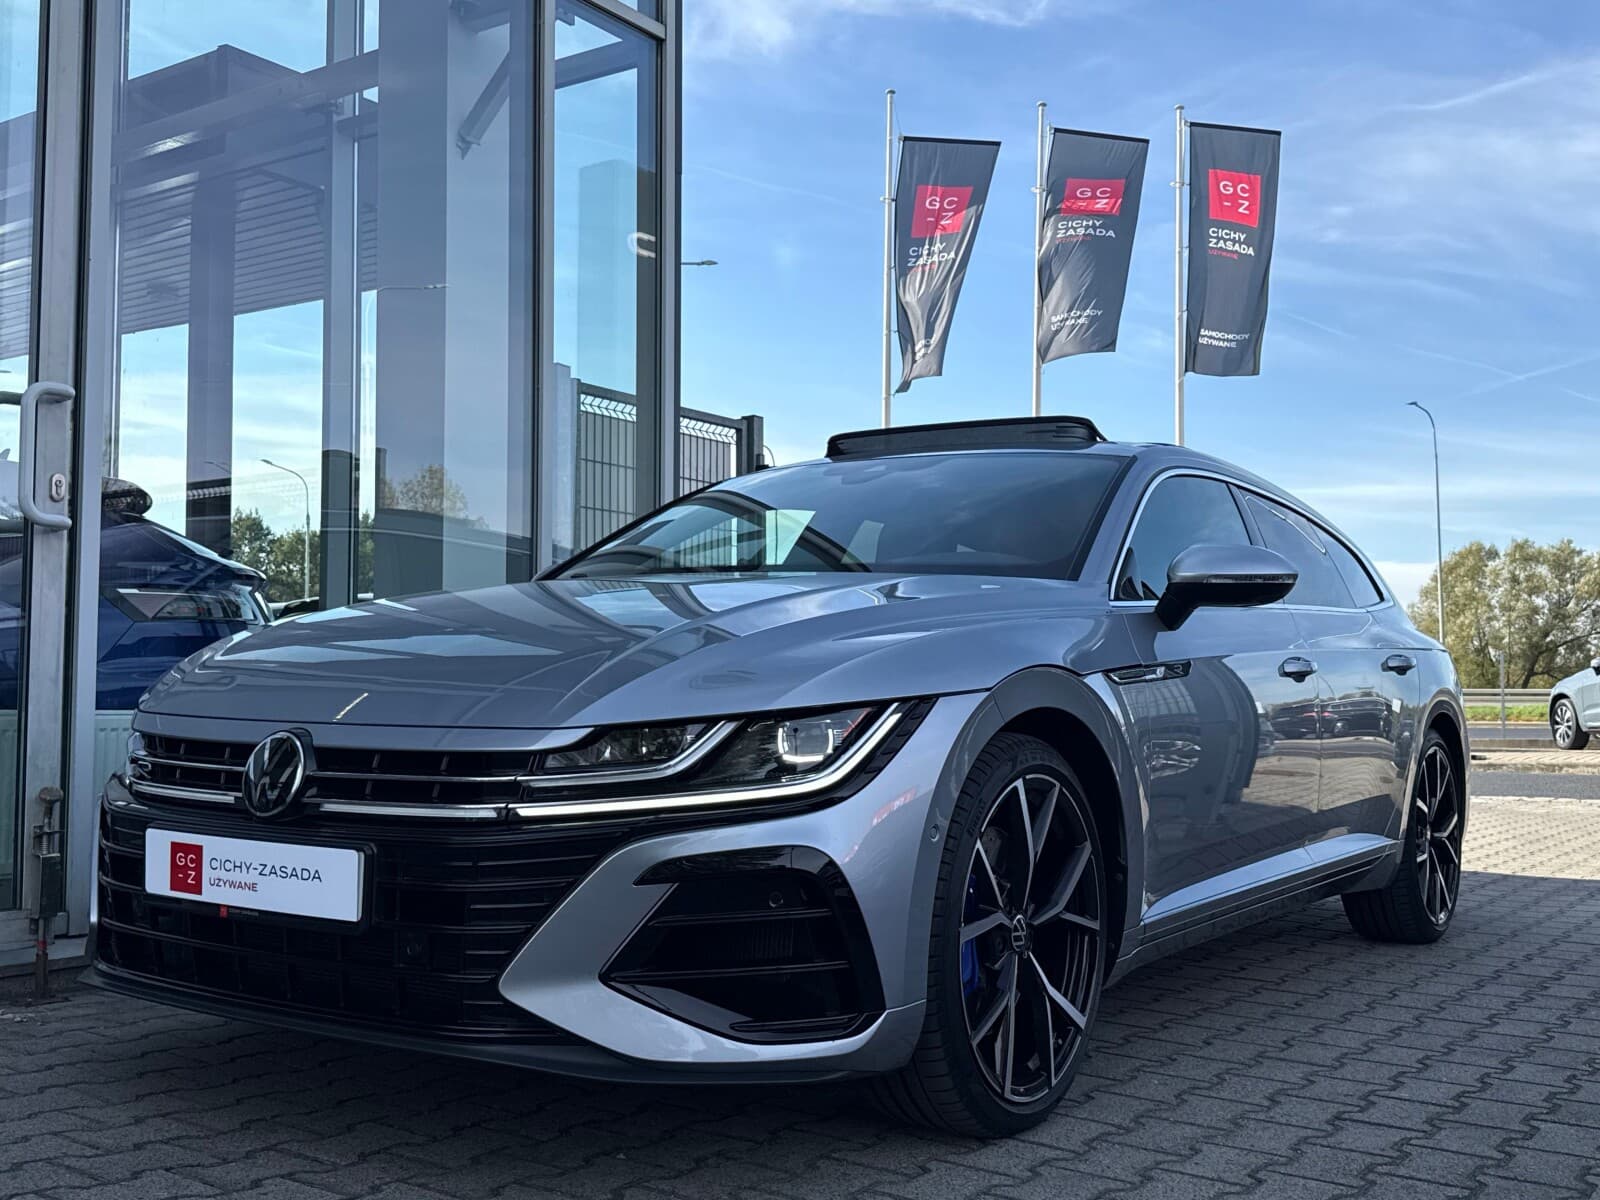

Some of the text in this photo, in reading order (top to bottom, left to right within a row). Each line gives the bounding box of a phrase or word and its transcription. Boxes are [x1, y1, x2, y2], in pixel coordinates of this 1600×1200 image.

[1058, 220, 1103, 229] CICHY
[1056, 228, 1116, 238] ZASADA
[1208, 227, 1246, 242] CICHY
[1208, 238, 1255, 256] ZASADA
[1200, 328, 1250, 340] SAMOCHODY
[176, 852, 196, 868] GC
[209, 857, 322, 883] CICHY-ZASADA
